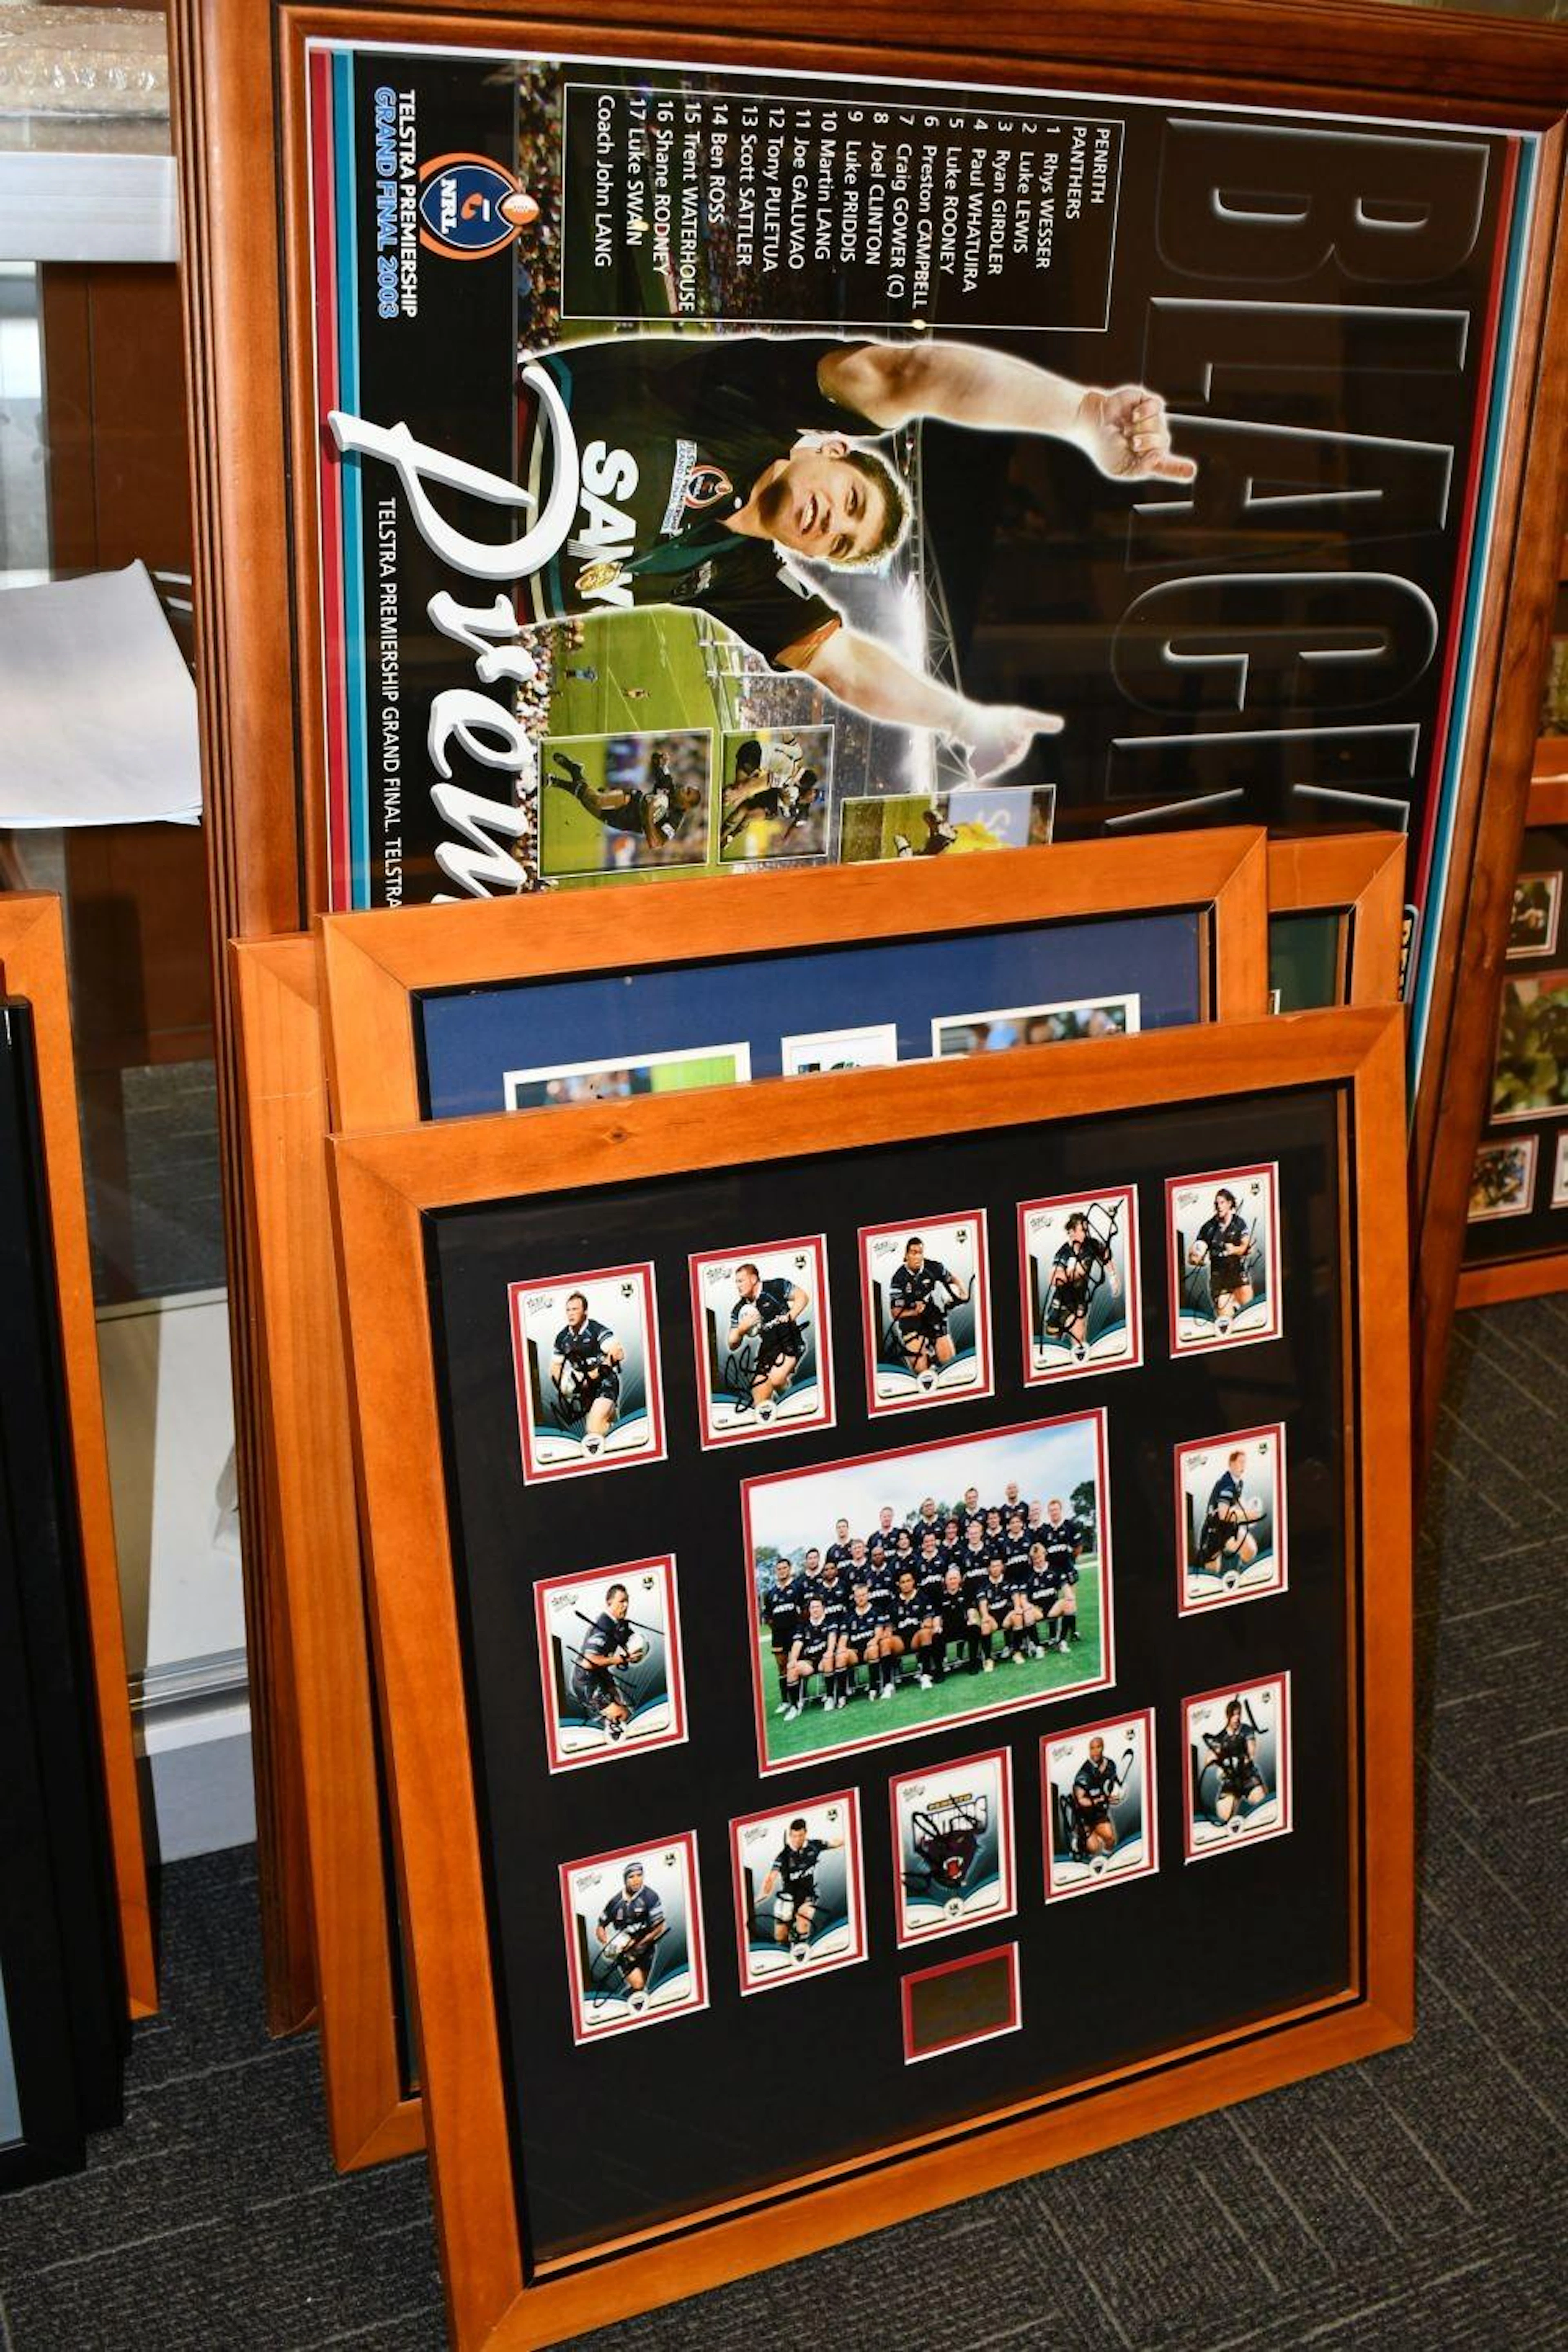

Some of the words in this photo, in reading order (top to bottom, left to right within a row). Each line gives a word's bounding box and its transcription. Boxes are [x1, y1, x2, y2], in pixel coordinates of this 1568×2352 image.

[375, 87, 396, 177] GRAND
[399, 89, 416, 180] TELSTRA
[597, 95, 615, 154] Coach
[630, 99, 646, 120] 17
[657, 100, 674, 122] 16
[684, 102, 702, 123] 15
[712, 104, 728, 125] 14
[742, 106, 758, 126] 13
[769, 107, 785, 128] 12
[795, 109, 811, 128] 11
[821, 111, 837, 131] 10
[848, 111, 863, 122] 9
[873, 112, 889, 123] 8
[899, 116, 915, 125] 7
[924, 116, 939, 127] 6
[949, 118, 964, 128] 5
[974, 118, 988, 130] 4
[998, 121, 1013, 131] 3
[1022, 123, 1037, 133] 2
[628, 128, 646, 174] Luke
[655, 129, 673, 187] Shane
[683, 131, 700, 181] Trent
[710, 133, 728, 168] Ben
[739, 134, 757, 182] Scott
[762, 136, 784, 181] Tony
[793, 137, 810, 169] Joe
[818, 139, 836, 201] Martin
[844, 140, 862, 185] Luke
[871, 142, 887, 178] Joel
[891, 143, 912, 191] Craig
[944, 147, 962, 190] Luke
[970, 148, 987, 186] Paul
[992, 150, 1011, 193] Ryan
[1017, 151, 1034, 194] Luke
[1039, 153, 1058, 193] Rhys
[1065, 127, 1087, 219] PANTHERS
[1091, 128, 1110, 203] PENRITH
[596, 160, 614, 206] John
[708, 175, 726, 223] ROSS
[919, 145, 937, 213] Preston
[376, 180, 397, 251] FINAL
[441, 178, 457, 234] NRL
[626, 180, 645, 245] SWAIN
[736, 187, 755, 266] SATTLER
[763, 186, 782, 272] PULETUA
[788, 175, 808, 269] GALUVAO
[840, 191, 859, 262] PRIDDIS
[865, 184, 885, 265] CLINTON
[890, 197, 909, 267] GOWER
[1013, 200, 1031, 253] LEWIS
[400, 184, 417, 318] PREMIERSHIP
[595, 213, 612, 266] LANG
[653, 194, 671, 276] RODNEY
[678, 187, 699, 312] WATERHOUSE
[815, 208, 832, 260] LANG
[940, 196, 959, 274] ROONEY
[962, 192, 983, 292] WHATUIRA
[988, 199, 1007, 274] GIRDLER
[1036, 198, 1054, 268] WESSER
[377, 256, 399, 318] 2003
[886, 274, 905, 298] (C)
[913, 219, 932, 308] CAMPBELL
[1104, 117, 1491, 835] BLACK
[379, 498, 396, 577] TELSTRA
[567, 440, 639, 613] SANY
[380, 583, 399, 702] PREMIERSHIP
[382, 706, 400, 772] GRAND
[383, 778, 401, 832] FINAL.
[385, 837, 401, 908] TELSTRA
